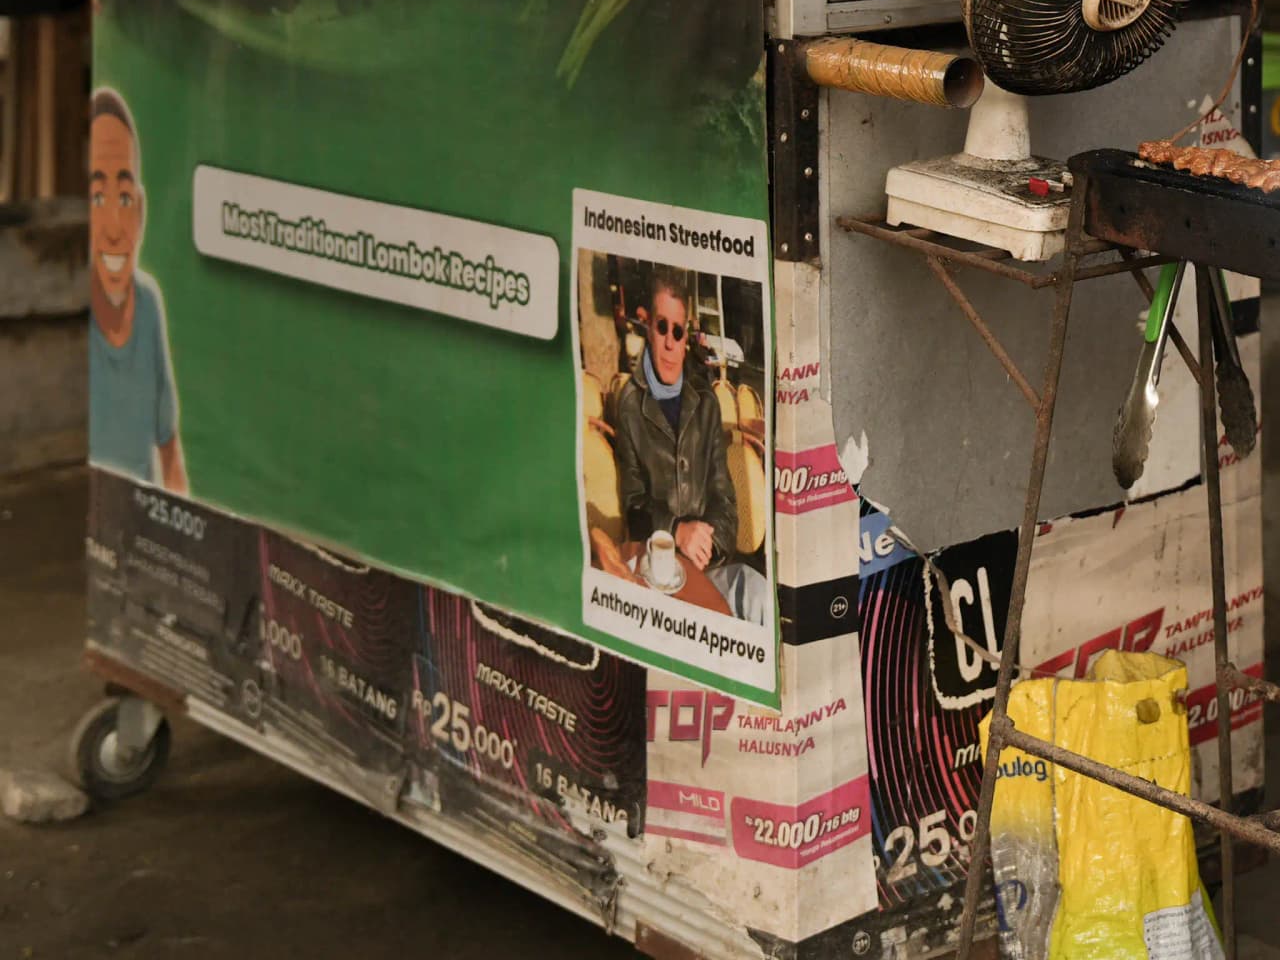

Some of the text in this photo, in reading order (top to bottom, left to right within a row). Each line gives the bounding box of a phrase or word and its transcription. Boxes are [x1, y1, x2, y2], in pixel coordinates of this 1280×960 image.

[222, 200, 530, 310] Most Traditional Lombok Recipes
[584, 206, 755, 258] Indonesian Streetfood
[590, 586, 766, 664] Anthony Would Approve
[1164, 616, 1244, 657] HALUSYA
[338, 666, 398, 720] BATANG
[477, 662, 577, 733] MAXX TASTE
[737, 698, 847, 737] TAMPILANNYA
[646, 690, 735, 769] TOP
[738, 737, 816, 758] HALUSNYA
[535, 763, 553, 789] 16
[679, 790, 721, 811] MILD
